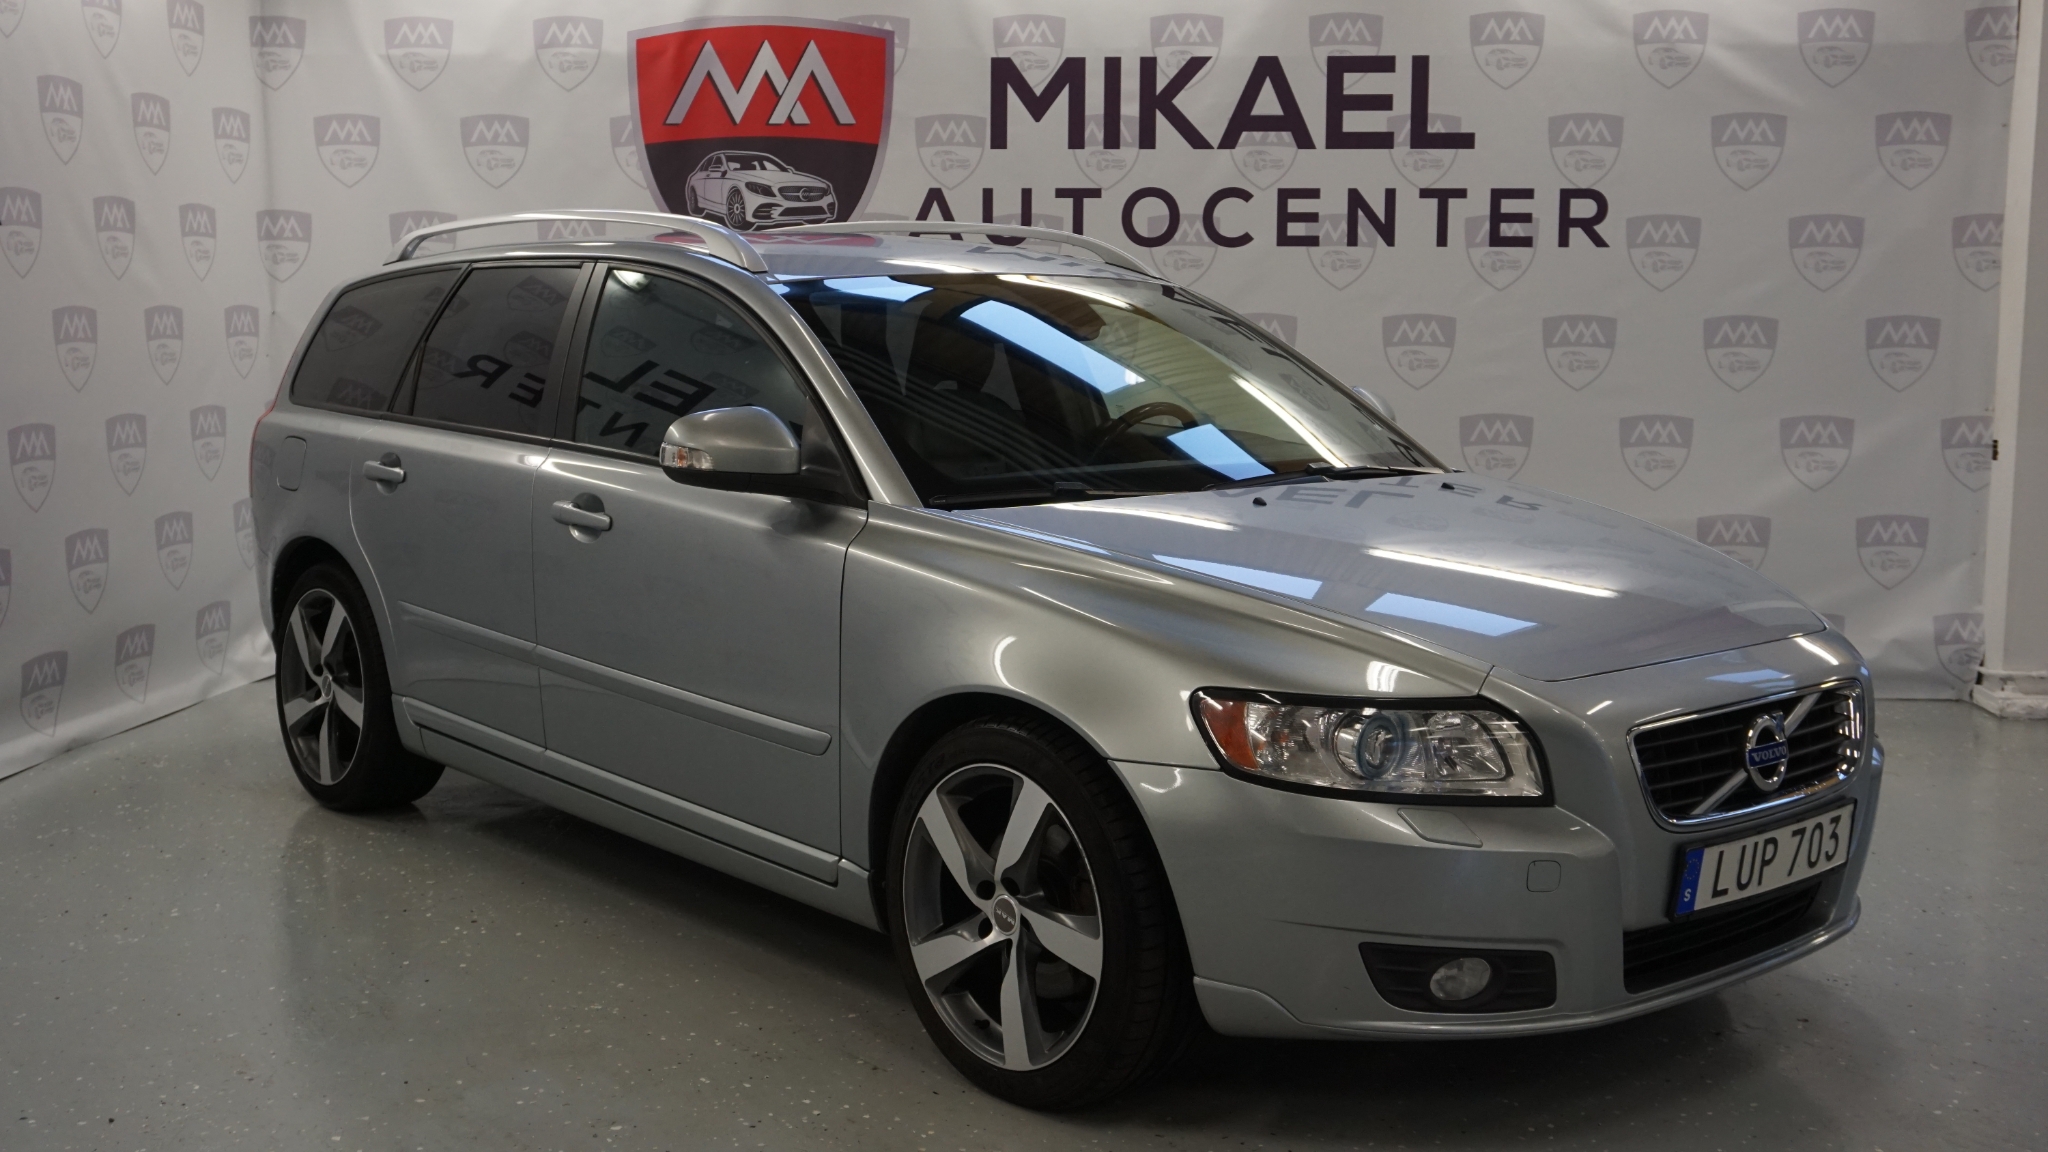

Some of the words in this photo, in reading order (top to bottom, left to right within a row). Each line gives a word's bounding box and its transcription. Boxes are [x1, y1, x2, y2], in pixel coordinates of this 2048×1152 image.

[989, 54, 1476, 150] MIKAEL
[908, 186, 1610, 248] AUTOCENTER
[1751, 745, 1787, 763] VOLVO
[1711, 836, 1779, 899] LUP
[1787, 814, 1843, 878] 703
[1683, 888, 1692, 902] S
